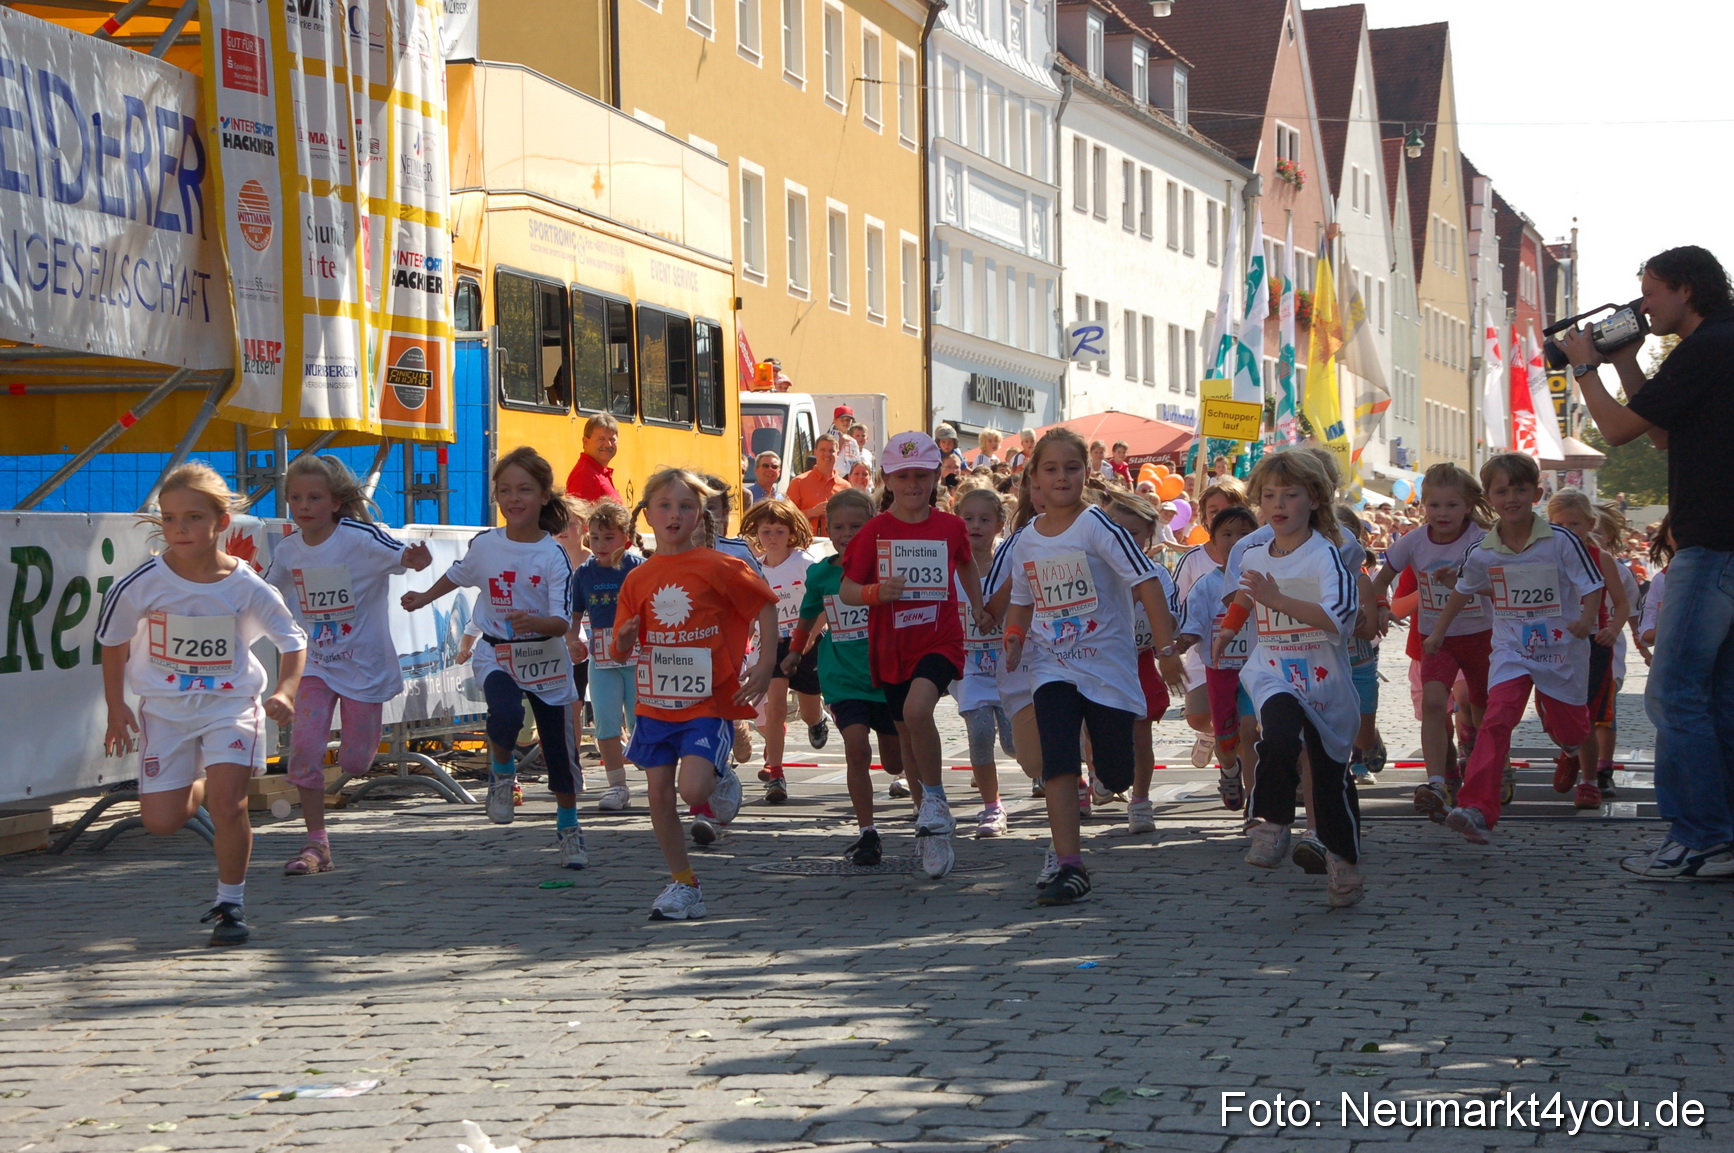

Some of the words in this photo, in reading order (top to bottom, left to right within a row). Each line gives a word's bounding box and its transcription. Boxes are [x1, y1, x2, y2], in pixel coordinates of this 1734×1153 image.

[222, 133, 275, 156] HACKNER
[238, 212, 272, 226] WITTMANN
[528, 218, 577, 250] SPORTRONIC
[650, 258, 671, 284] EVENT
[672, 266, 698, 292] SERVICE
[244, 338, 281, 363] MERZ
[1207, 409, 1257, 421] Schnupper-
[1223, 421, 1239, 430] lauf
[1128, 453, 1171, 465] Stadtcafé
[895, 545, 937, 558] Christina
[897, 567, 943, 583] 7033
[1042, 562, 1083, 583] NADJA
[309, 589, 349, 607] 7276
[1044, 580, 1088, 603] 7179
[1511, 588, 1554, 604] 7226
[840, 608, 868, 626] 723
[903, 612, 924, 623] DEHN
[677, 625, 719, 643] Reisen
[1134, 632, 1153, 647] 92
[172, 637, 227, 657] 7268
[514, 648, 544, 659] Melina
[654, 652, 694, 666] Marlene
[518, 659, 561, 680] 7077
[639, 669, 645, 679] KI
[425, 675, 441, 694] the
[443, 672, 465, 692] line.
[658, 674, 706, 694] 7125
